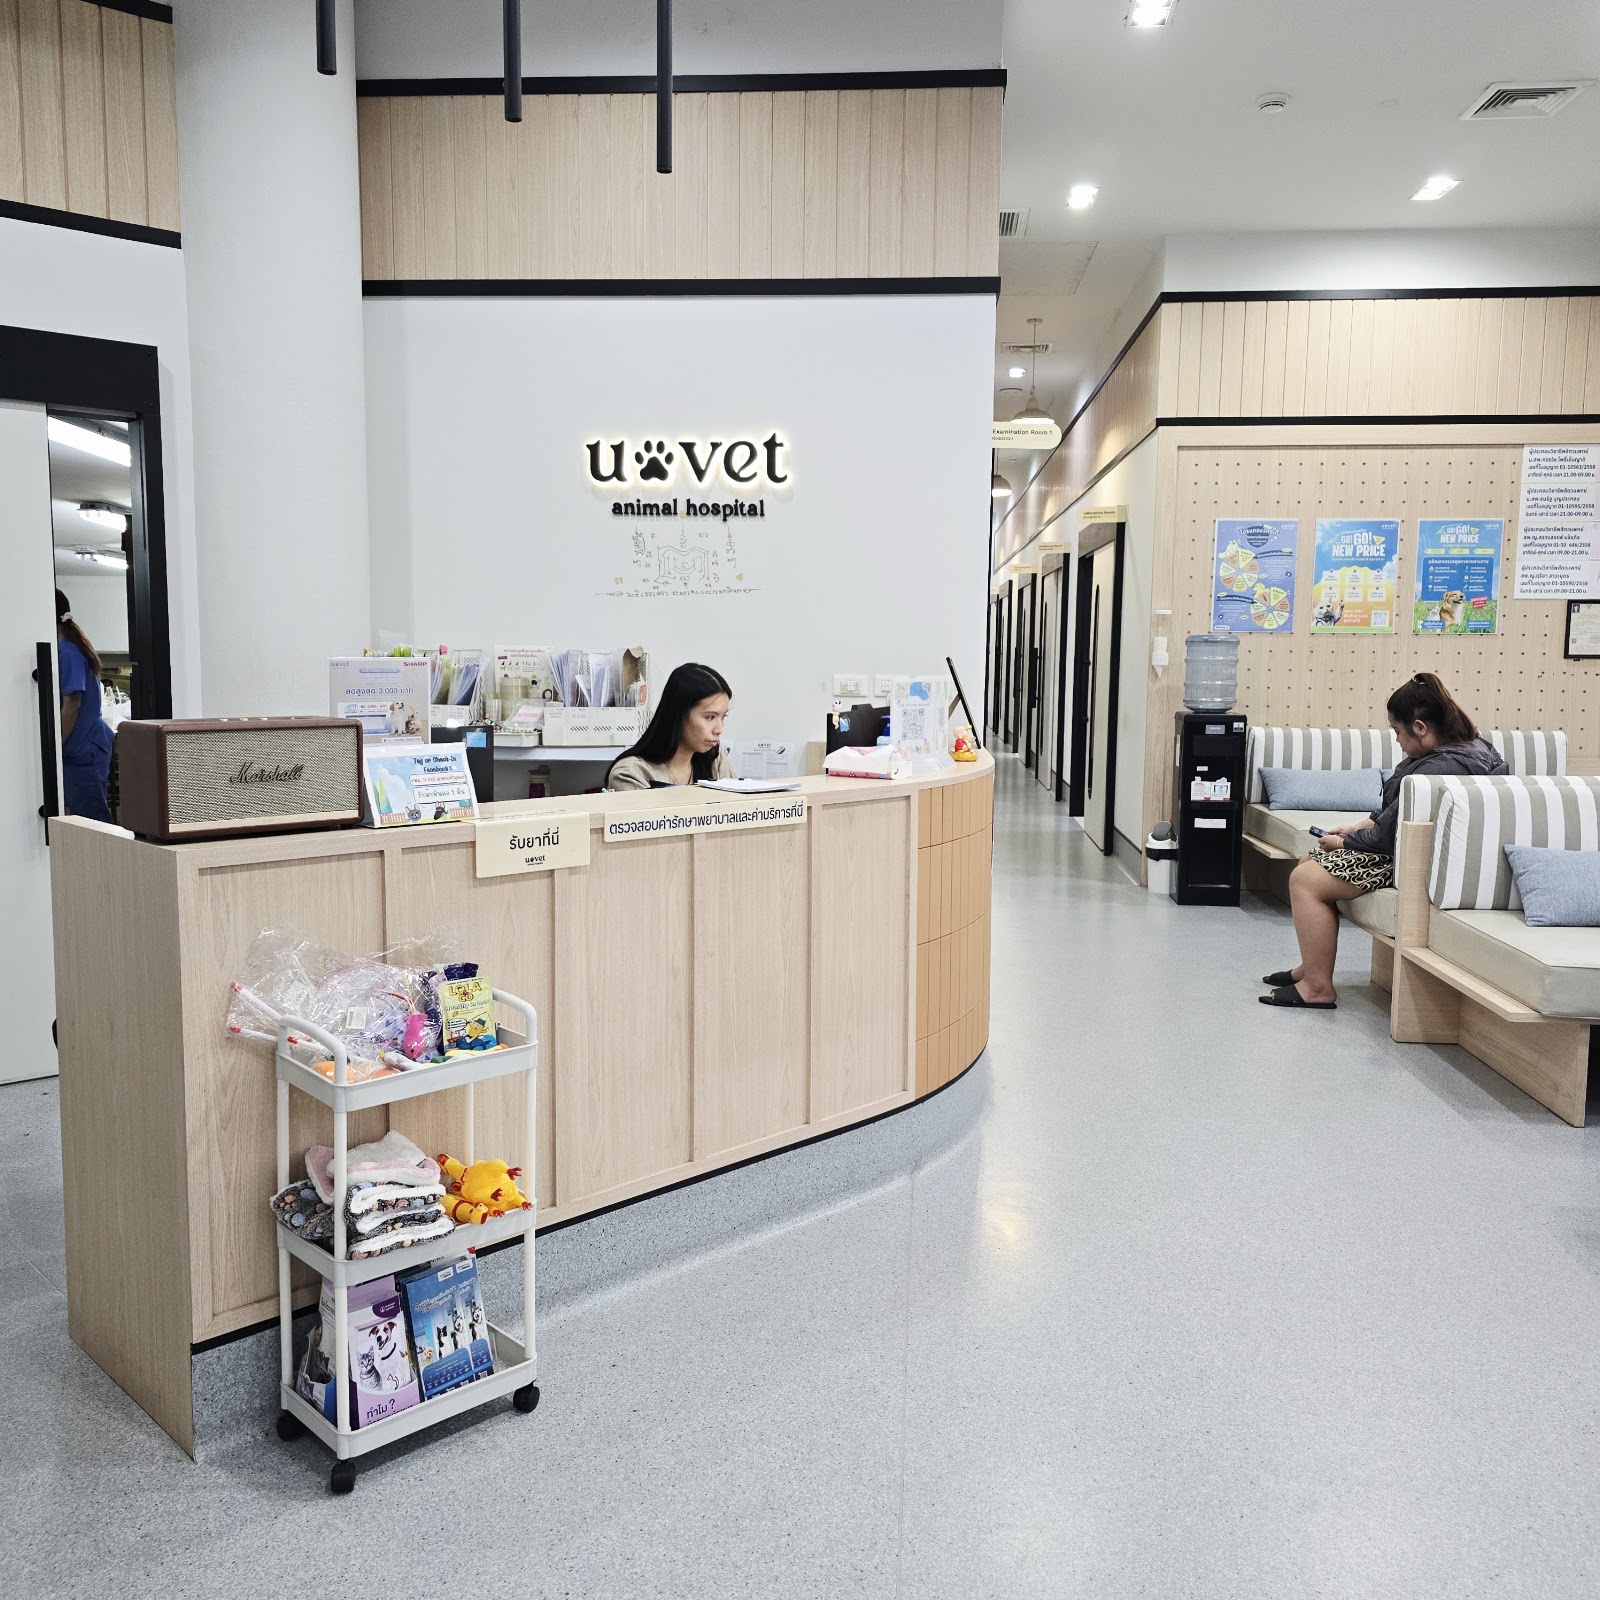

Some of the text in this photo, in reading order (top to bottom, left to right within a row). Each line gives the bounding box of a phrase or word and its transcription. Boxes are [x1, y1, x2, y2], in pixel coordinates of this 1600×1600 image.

[611, 498, 765, 522] animal hospital
[1455, 524, 1471, 535] GO!
[1353, 531, 1373, 546] GO!
[1439, 533, 1480, 544] NEW PRICE
[1331, 544, 1386, 557] NEW PRICE
[345, 688, 376, 697] ลดสูงสุด
[413, 757, 424, 766] Tag
[432, 755, 457, 763] Check-In
[229, 761, 304, 784] Marshall
[423, 764, 449, 773] Facebook
[609, 800, 804, 835] ตรวจสอบค่ารักษาพยาบาลและค่าบริการที่นี่
[509, 826, 560, 850] รับยาที่นี่
[448, 981, 483, 997] LOLA
[366, 1404, 388, 1419] ทำไม
[388, 1398, 396, 1411] ?
